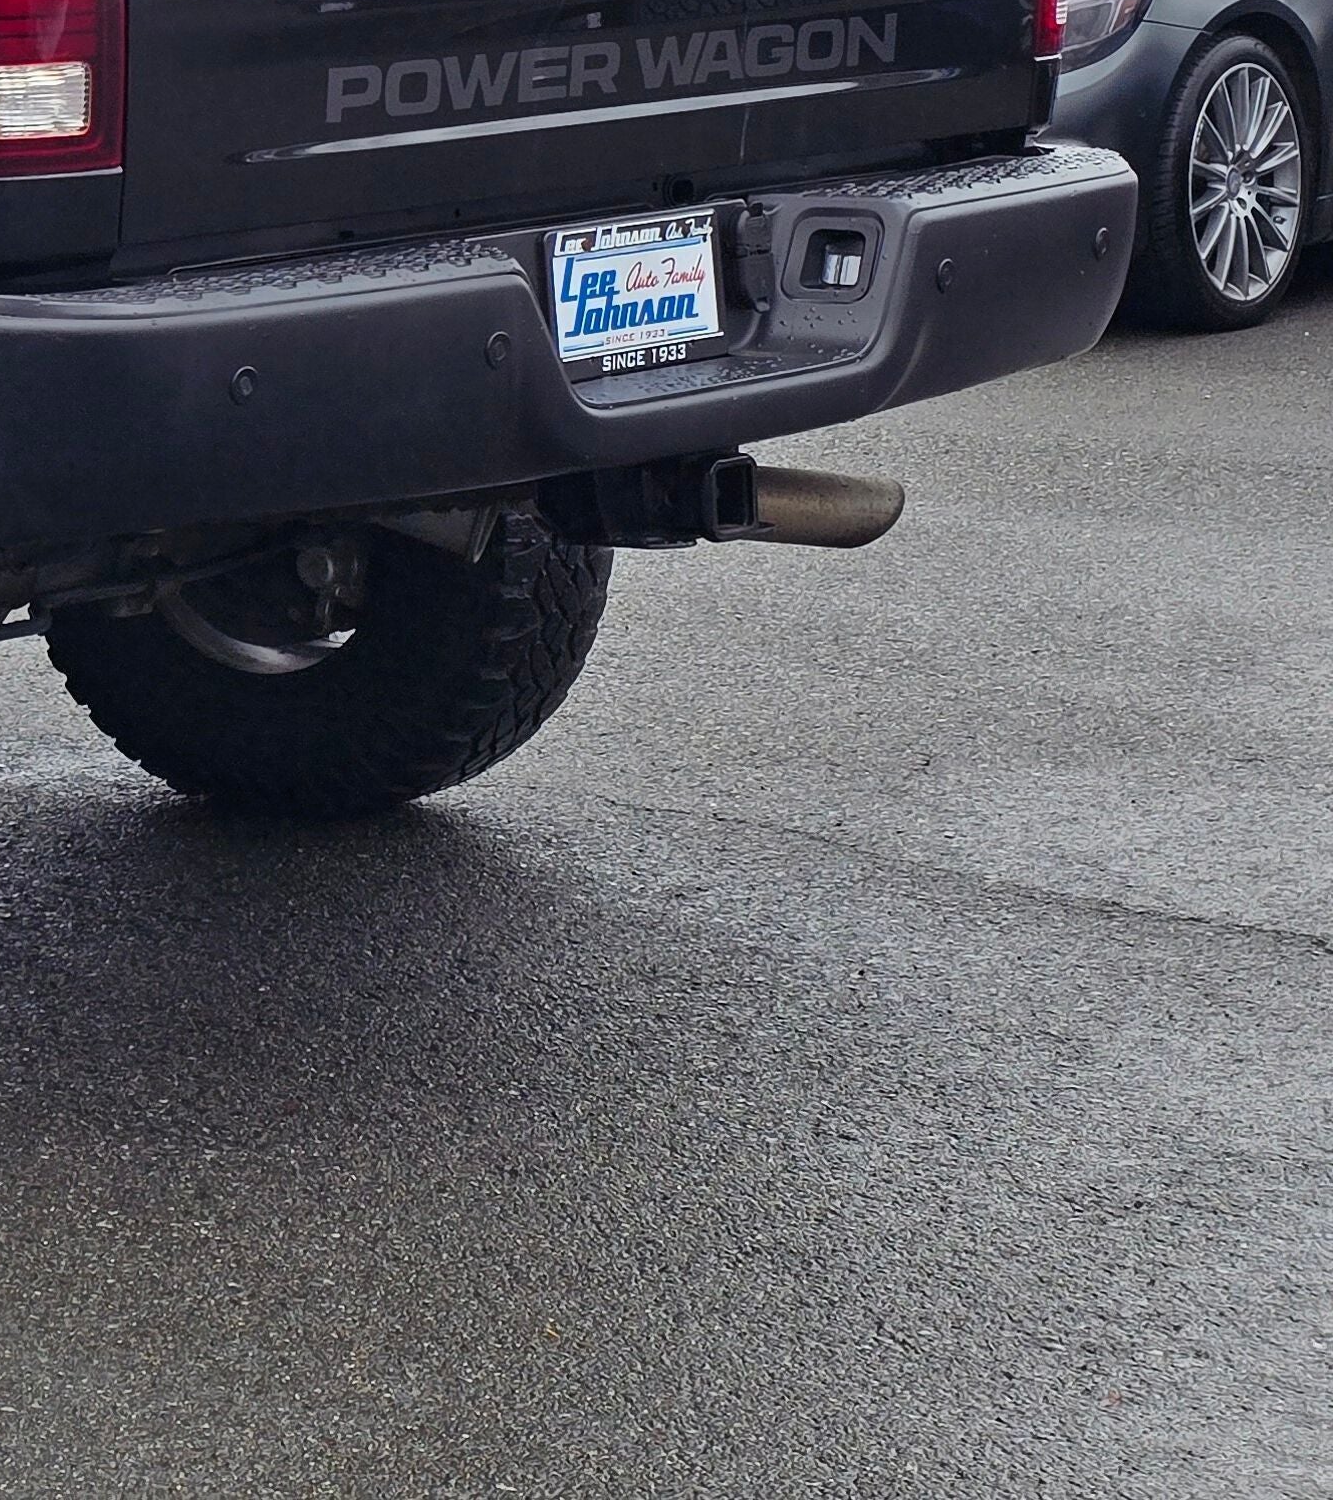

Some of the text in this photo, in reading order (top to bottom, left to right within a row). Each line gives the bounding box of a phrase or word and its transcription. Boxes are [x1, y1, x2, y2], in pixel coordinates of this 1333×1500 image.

[326, 12, 899, 123] POWER WAGON
[590, 225, 663, 251] Johnson
[560, 254, 706, 303] Lee Auto Family
[564, 288, 699, 338] Johnson
[606, 329, 665, 345] SINCE 1933
[601, 343, 686, 372] SINCE 1933
